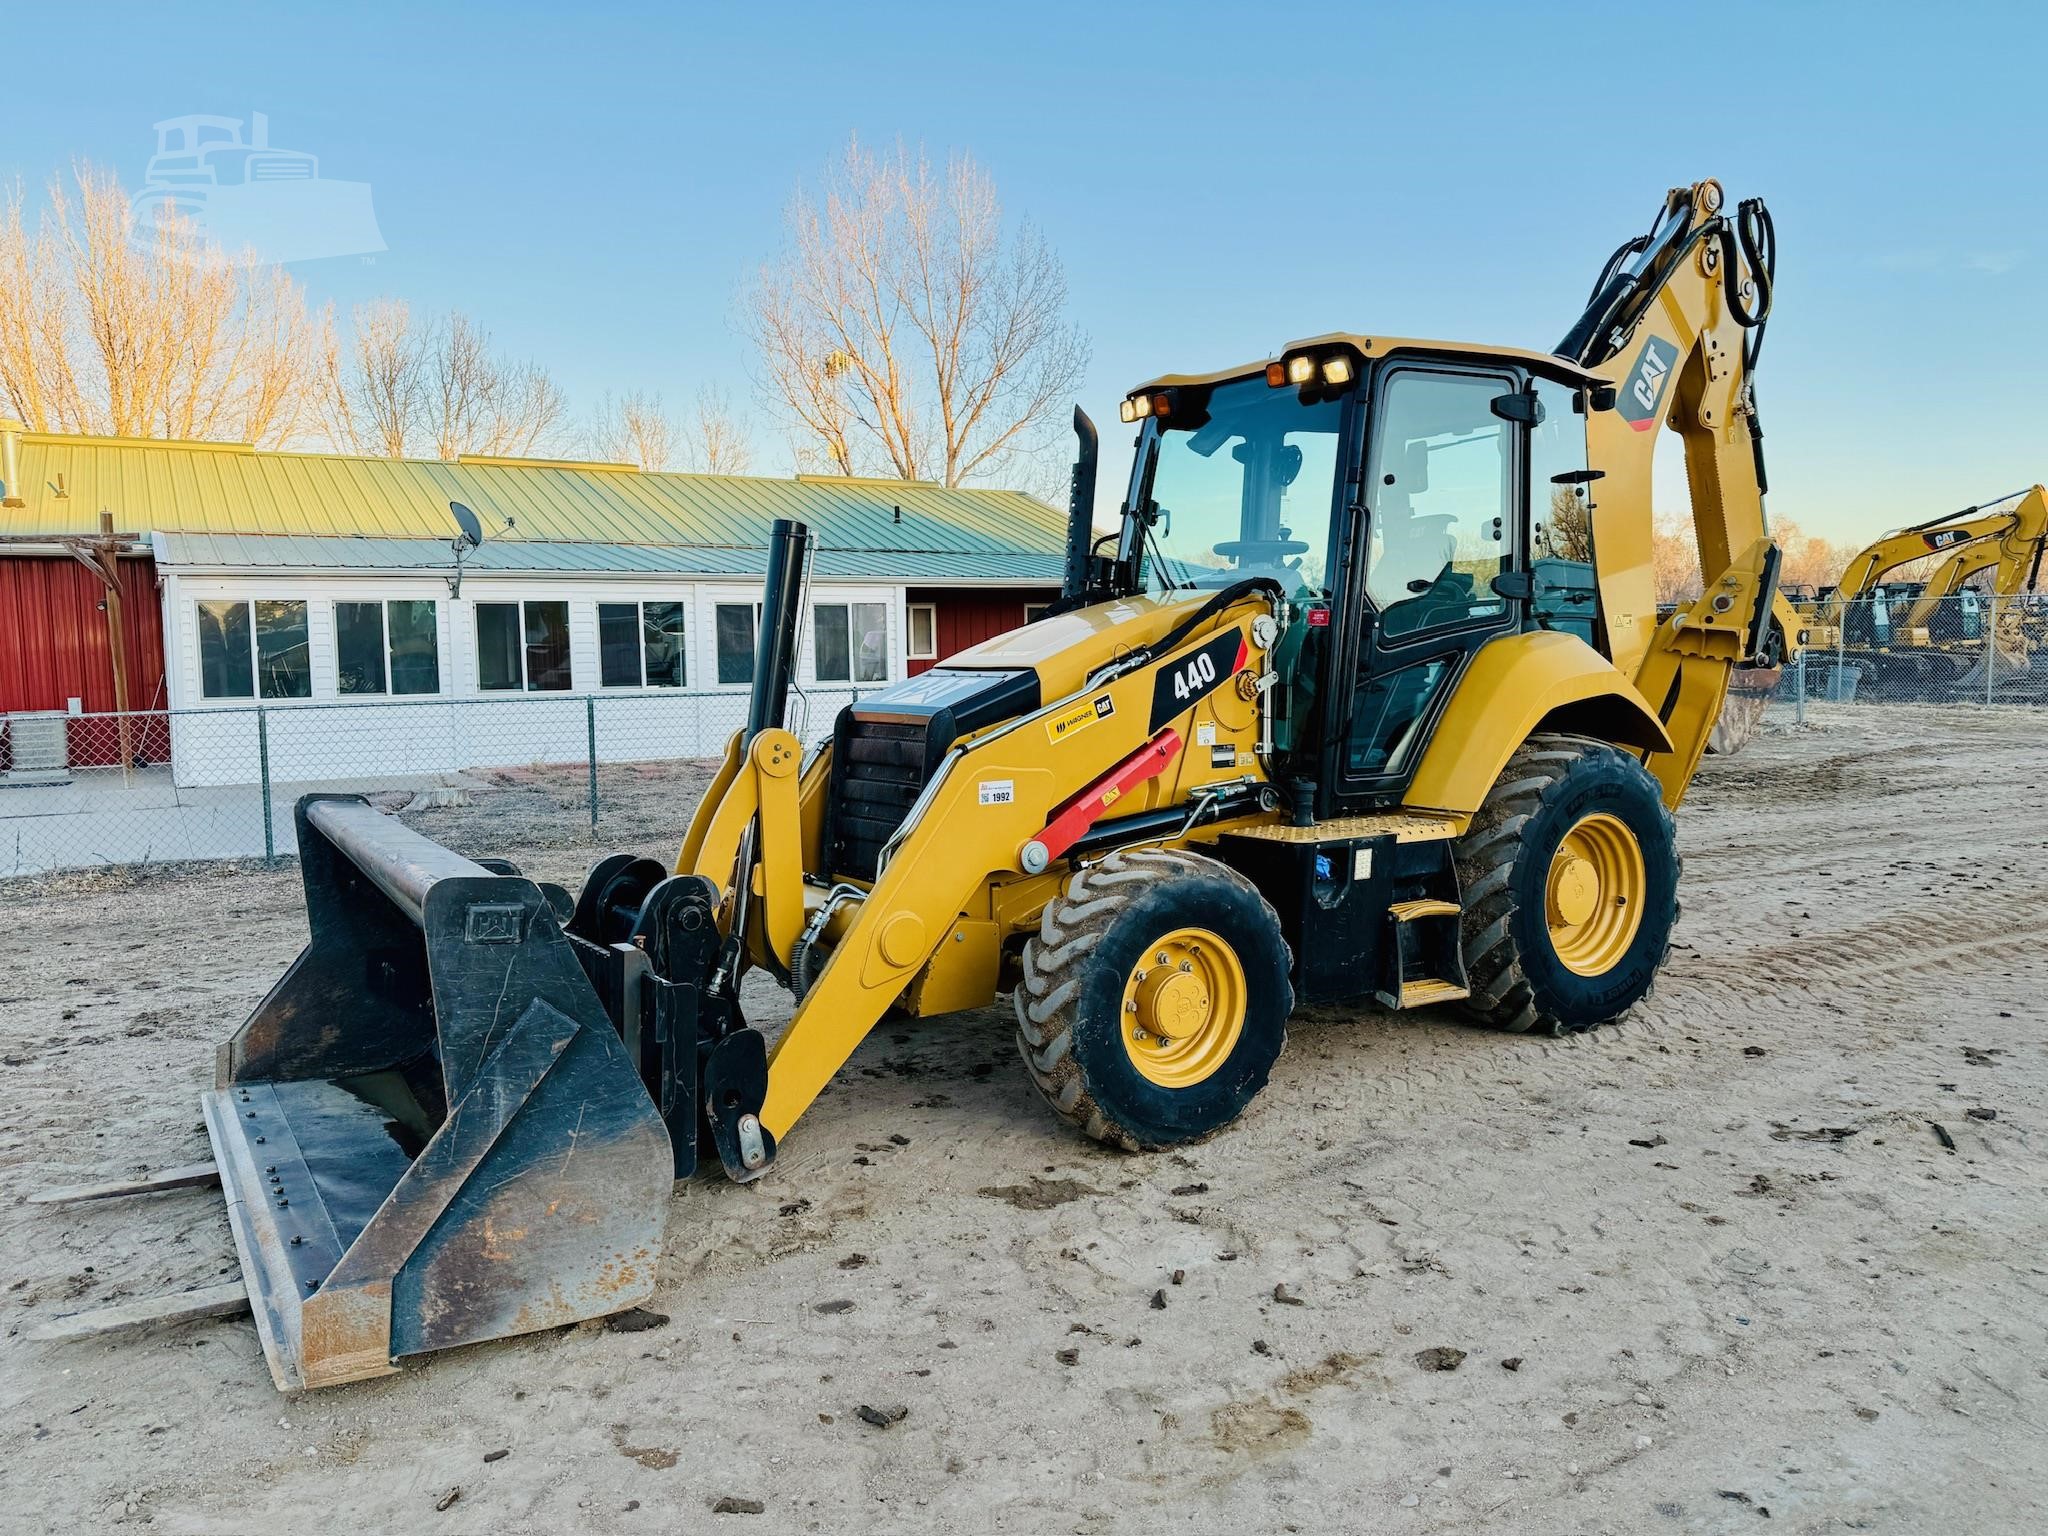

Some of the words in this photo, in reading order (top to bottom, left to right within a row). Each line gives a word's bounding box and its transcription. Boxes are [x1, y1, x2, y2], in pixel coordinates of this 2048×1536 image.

[1634, 344, 1667, 411] CAT
[1935, 531, 1955, 547] CAT
[1174, 652, 1216, 699] 440
[1066, 710, 1093, 727] WAGNER
[1096, 699, 1111, 714] CAT
[992, 792, 1010, 802] 1992
